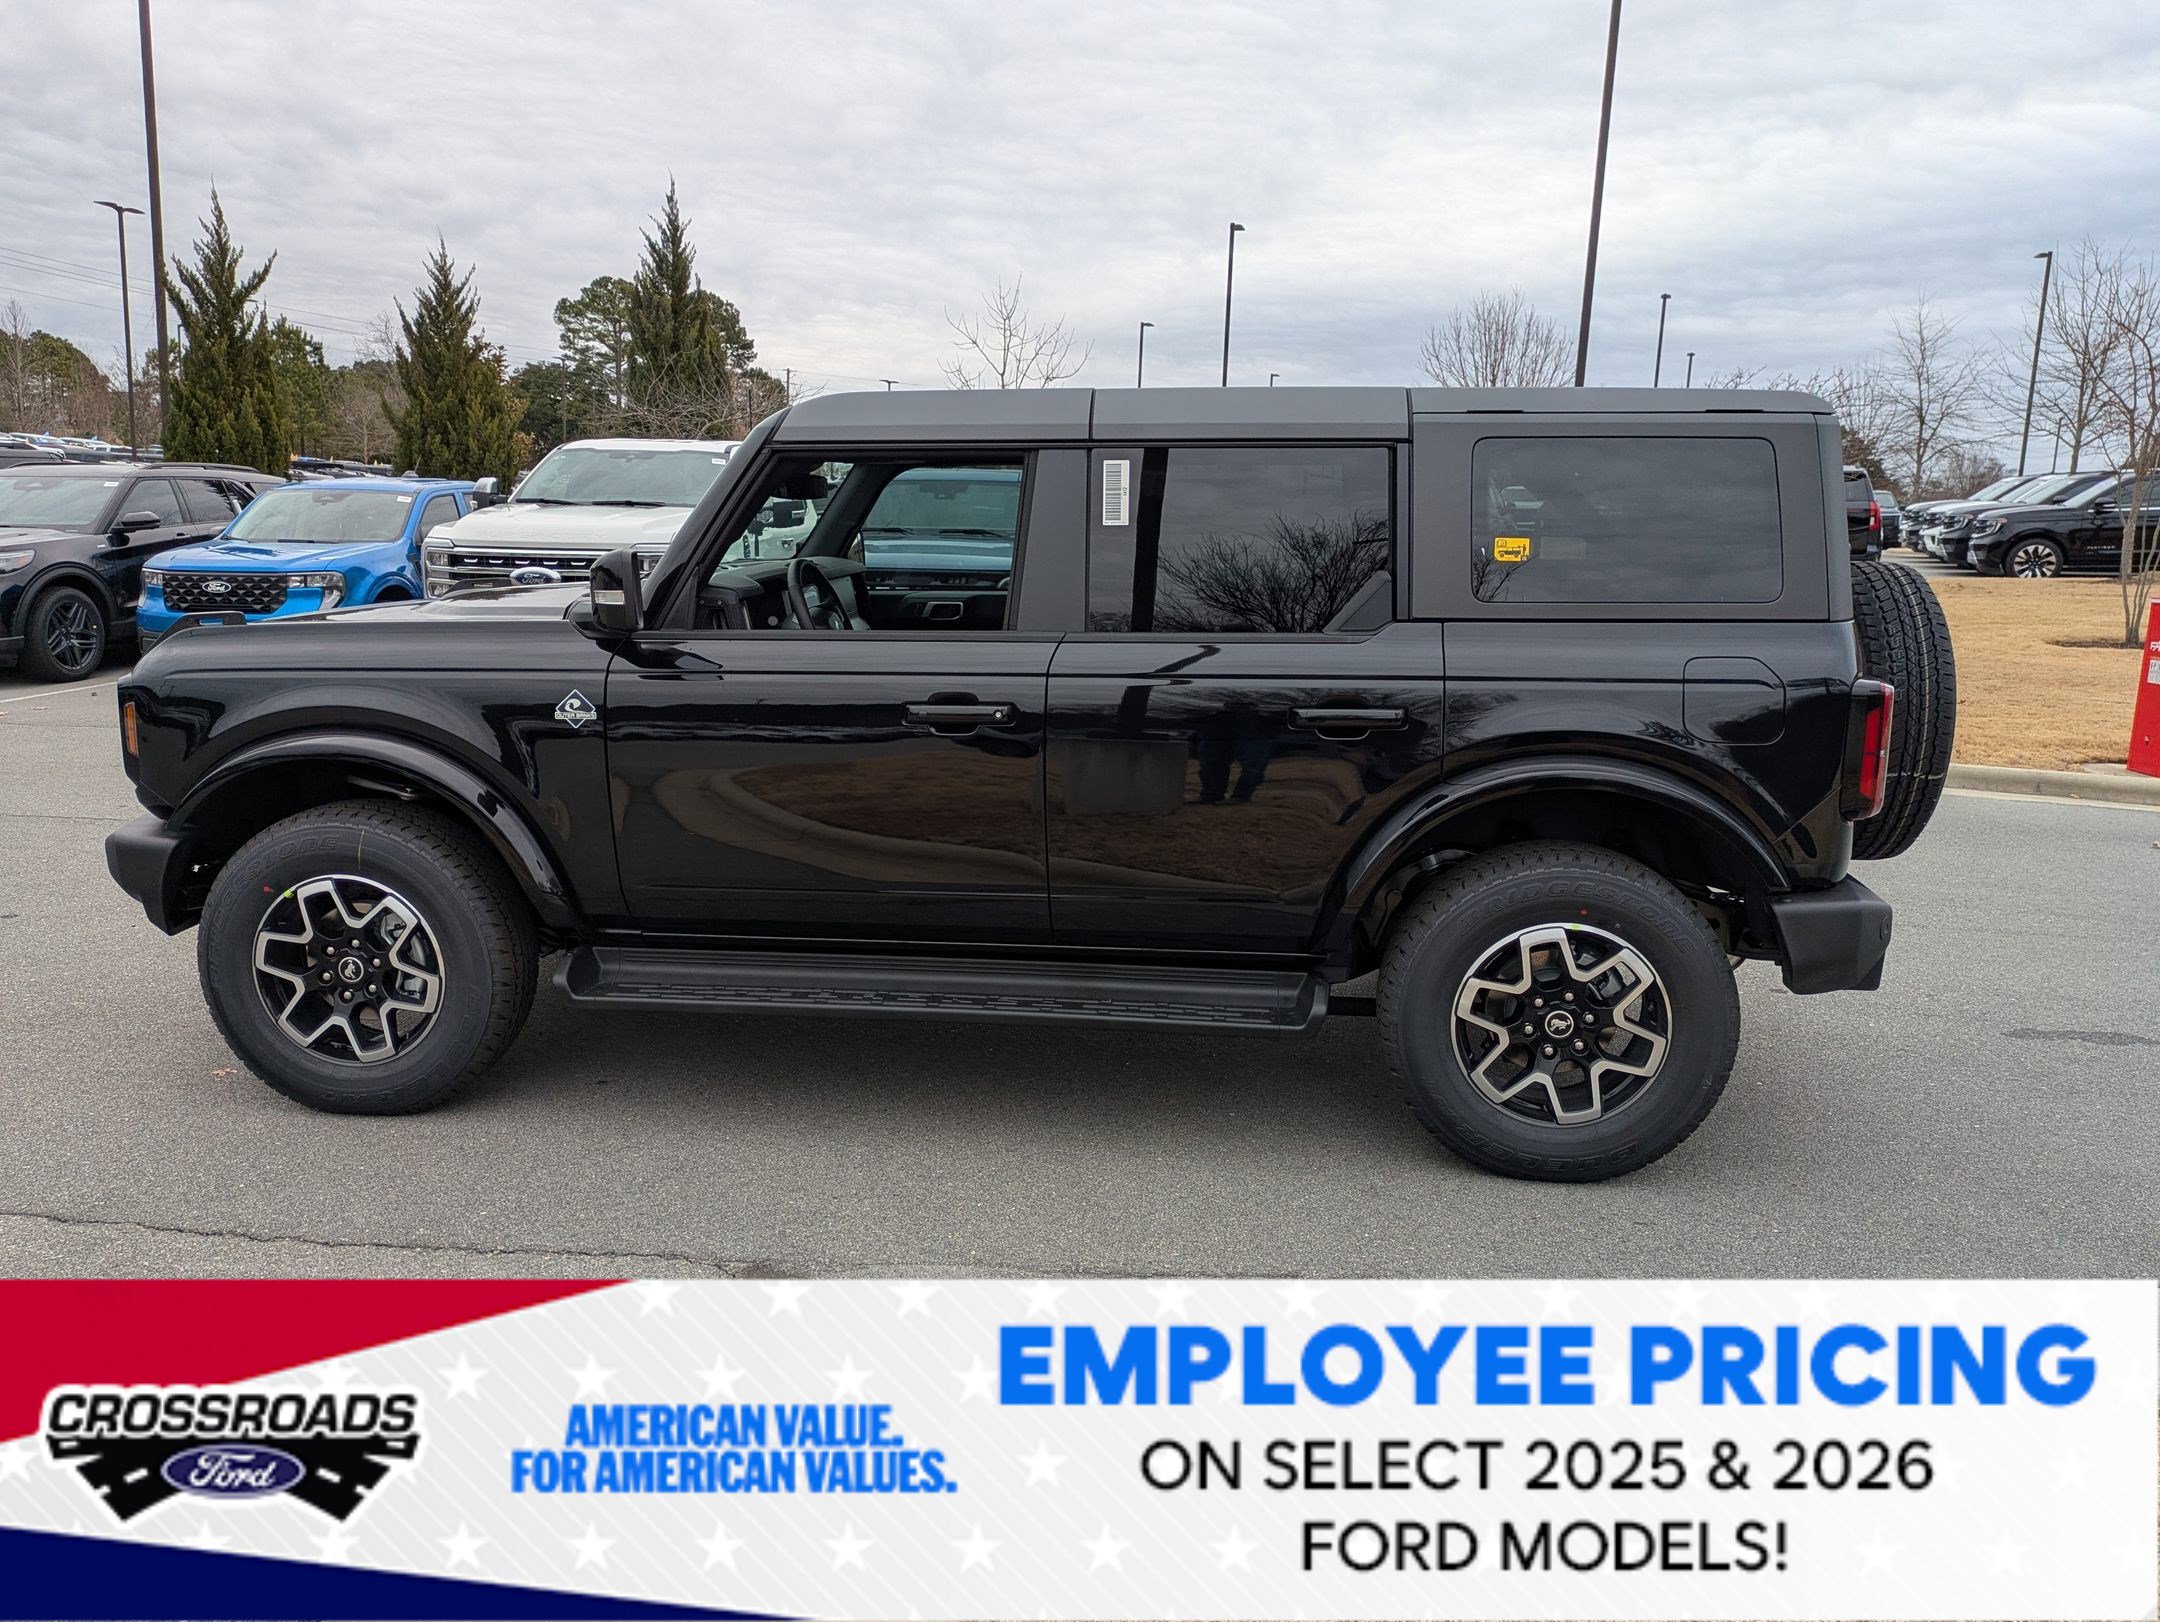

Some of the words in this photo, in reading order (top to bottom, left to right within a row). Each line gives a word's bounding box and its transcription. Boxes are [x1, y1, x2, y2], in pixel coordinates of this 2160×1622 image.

[522, 573, 546, 585] Ford
[207, 582, 226, 592] Ford
[1456, 878, 1696, 955] BRIDGESTONE
